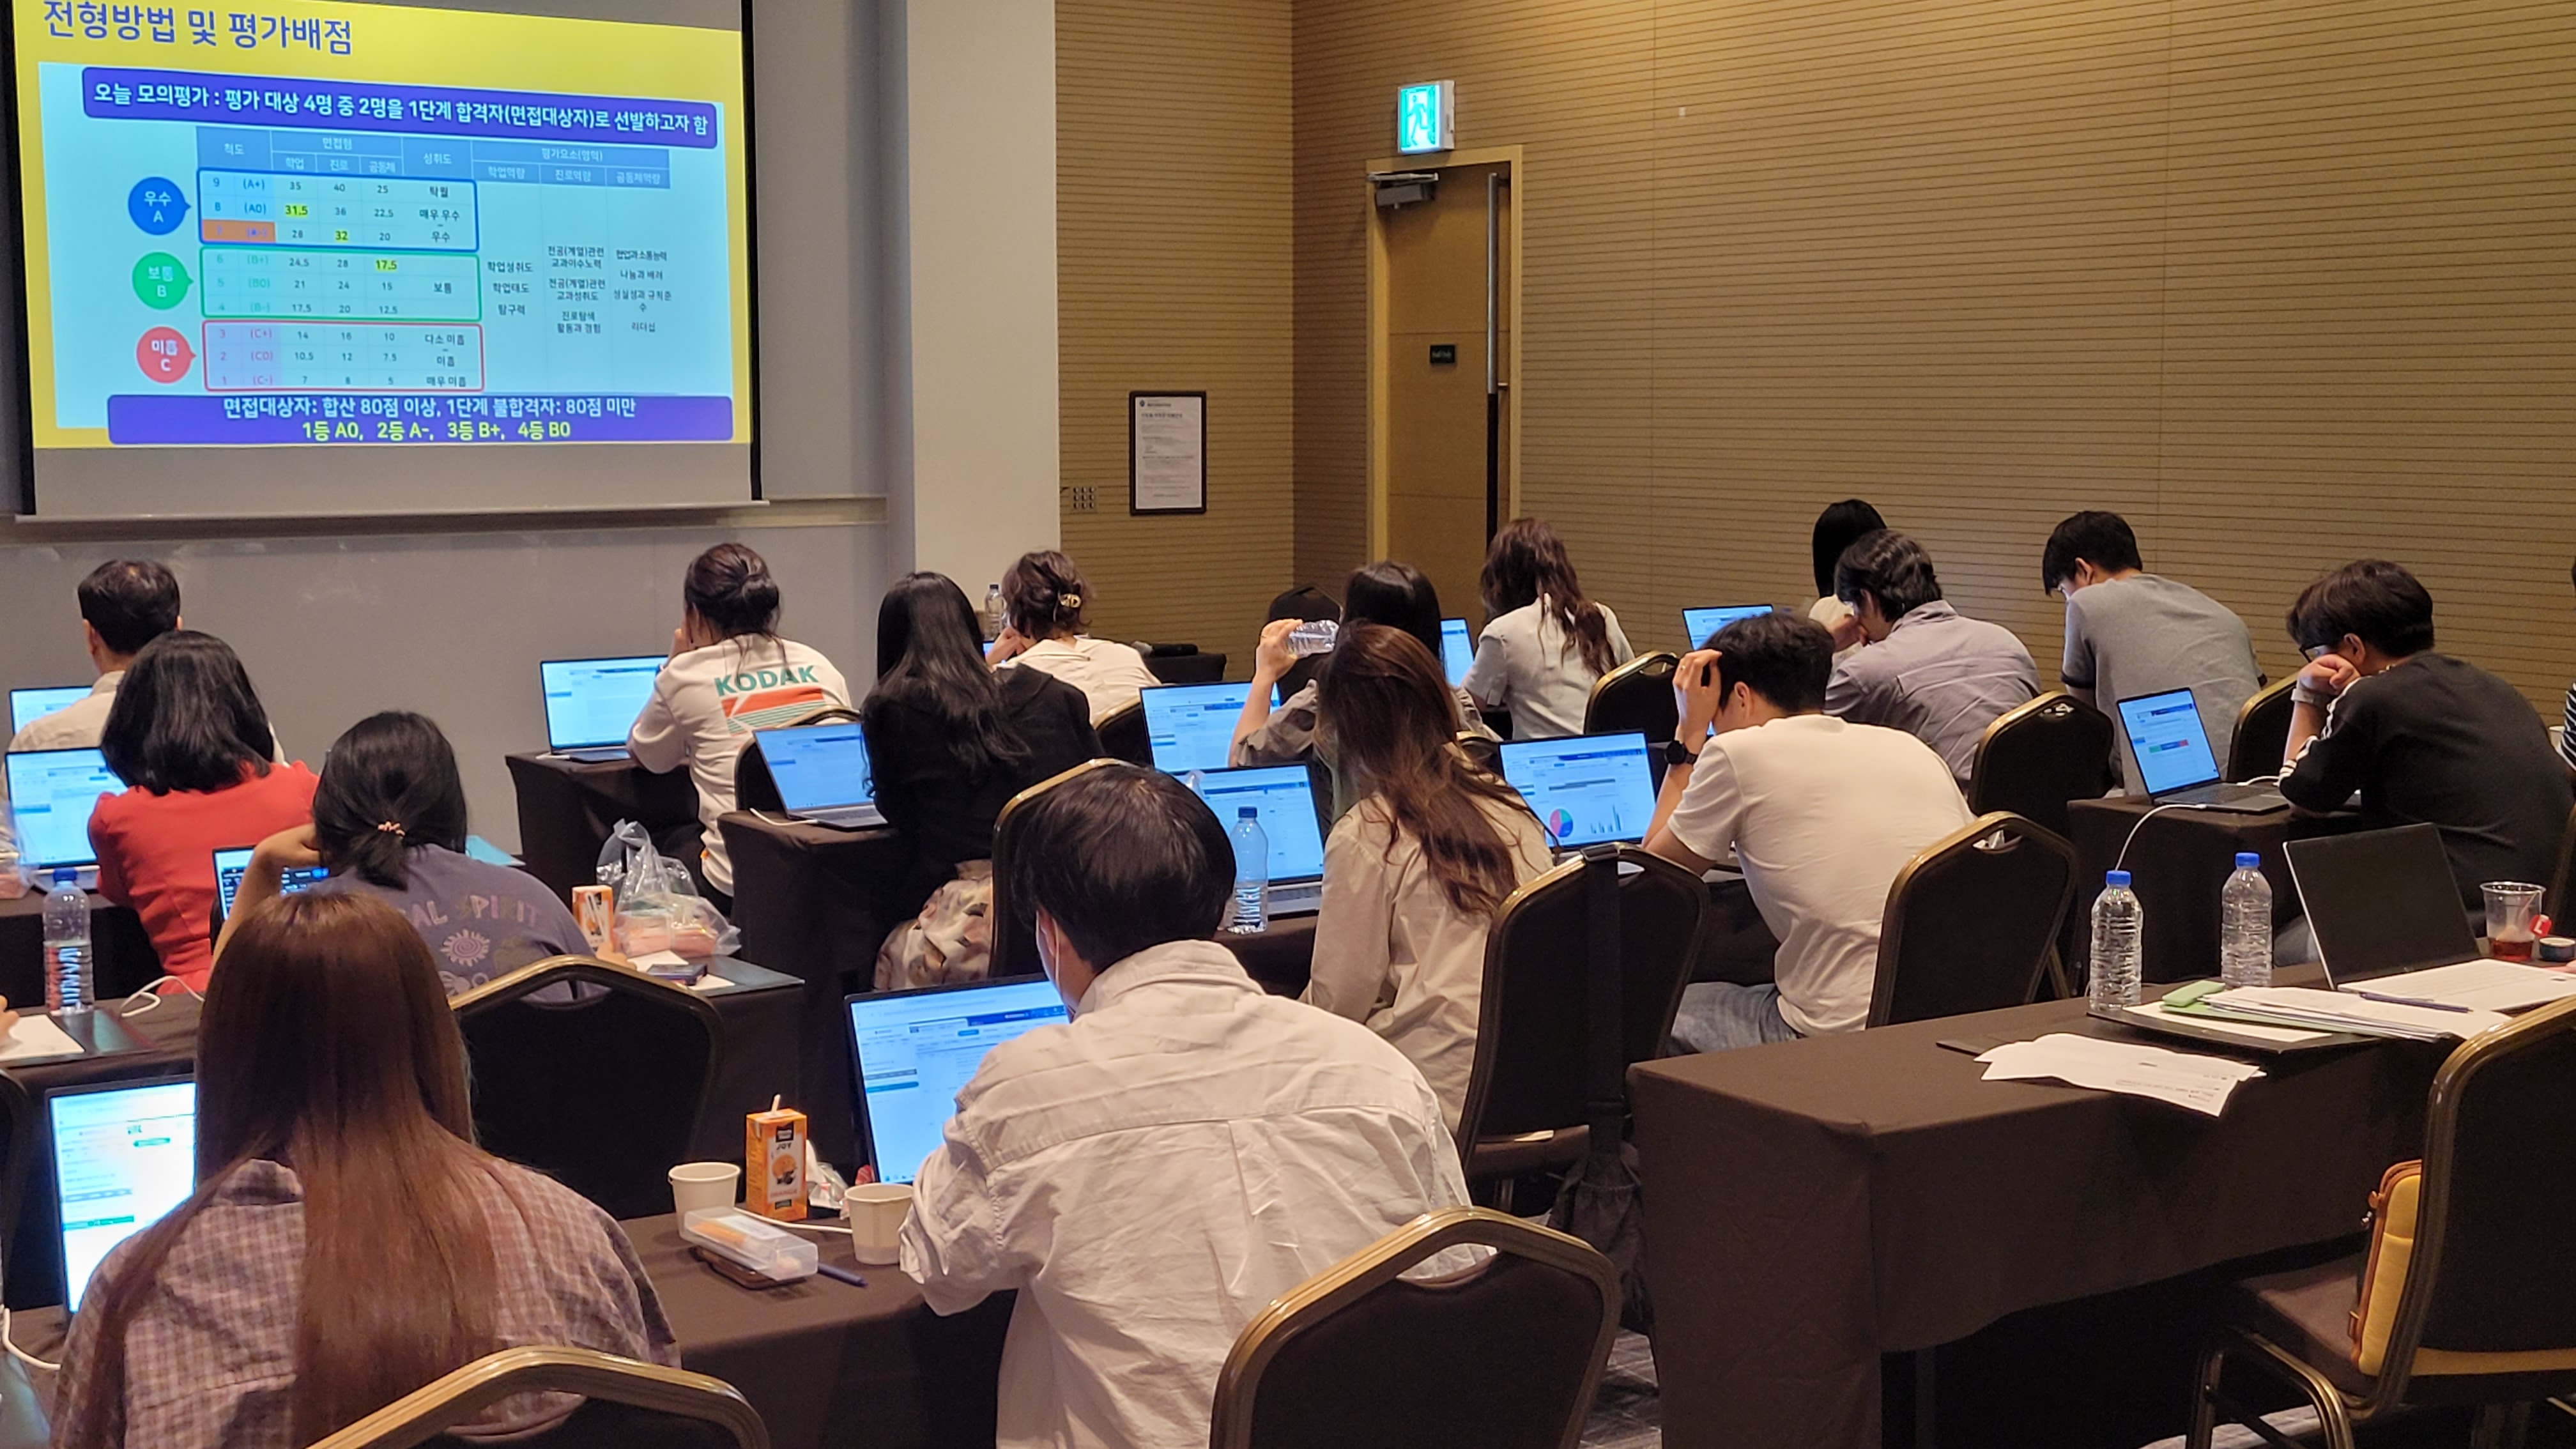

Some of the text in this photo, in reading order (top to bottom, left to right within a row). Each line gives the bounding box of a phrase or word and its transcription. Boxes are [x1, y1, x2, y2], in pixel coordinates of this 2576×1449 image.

[43, 1, 351, 56] 전형방법 및 평가배점
[94, 83, 132, 105] 오늘
[137, 84, 210, 107] 모의평가
[225, 89, 260, 111] 평가
[264, 91, 299, 114] 대상
[303, 94, 332, 116] 4명
[337, 95, 355, 116] 중
[358, 97, 404, 120] 2명을
[409, 100, 452, 121] 1단계
[456, 100, 610, 128] 합격자(면접대상자)로
[614, 110, 690, 133] 선발하고자
[693, 114, 709, 135] 함
[213, 178, 220, 187] 9
[243, 178, 265, 190] (A+)
[290, 181, 302, 190] 35
[334, 183, 345, 192] 40
[377, 185, 388, 194] 25
[144, 190, 172, 207] 우수
[285, 204, 308, 216] 31.5
[335, 207, 346, 216] 36
[374, 208, 394, 218] 22.5
[419, 208, 460, 221] 매우 우수
[153, 210, 164, 223] A
[335, 231, 348, 241] 32
[379, 233, 390, 241] 20
[432, 231, 450, 243] 우수
[217, 254, 223, 264] 6
[289, 258, 309, 268] 24.5
[337, 259, 348, 268] 28
[376, 259, 397, 270] 17.5
[218, 277, 224, 287] 5
[295, 280, 305, 289] 21
[339, 280, 349, 289] 24
[383, 282, 392, 291] 15
[157, 285, 167, 298] B
[292, 303, 311, 313] 17.5
[339, 305, 350, 314] 20
[379, 305, 397, 314] 12.5
[220, 328, 226, 339] 3
[298, 331, 308, 340] 14
[341, 332, 351, 341] 16
[385, 332, 394, 341] 10
[425, 334, 444, 345] 다소
[220, 351, 226, 361] 2
[295, 351, 314, 361] 10.5
[342, 353, 352, 362] 12
[384, 353, 397, 362] 7.5
[160, 358, 171, 371] C
[302, 376, 307, 385] 7
[388, 377, 394, 385] 5
[224, 397, 636, 418] 면접대상자: 합산 80점 이상, 1단계 불합격자: 80점 미만
[302, 420, 571, 441] 1등 A0, 2등 A-, 3등 B+, 4등 B0
[714, 665, 818, 696] KODAK
